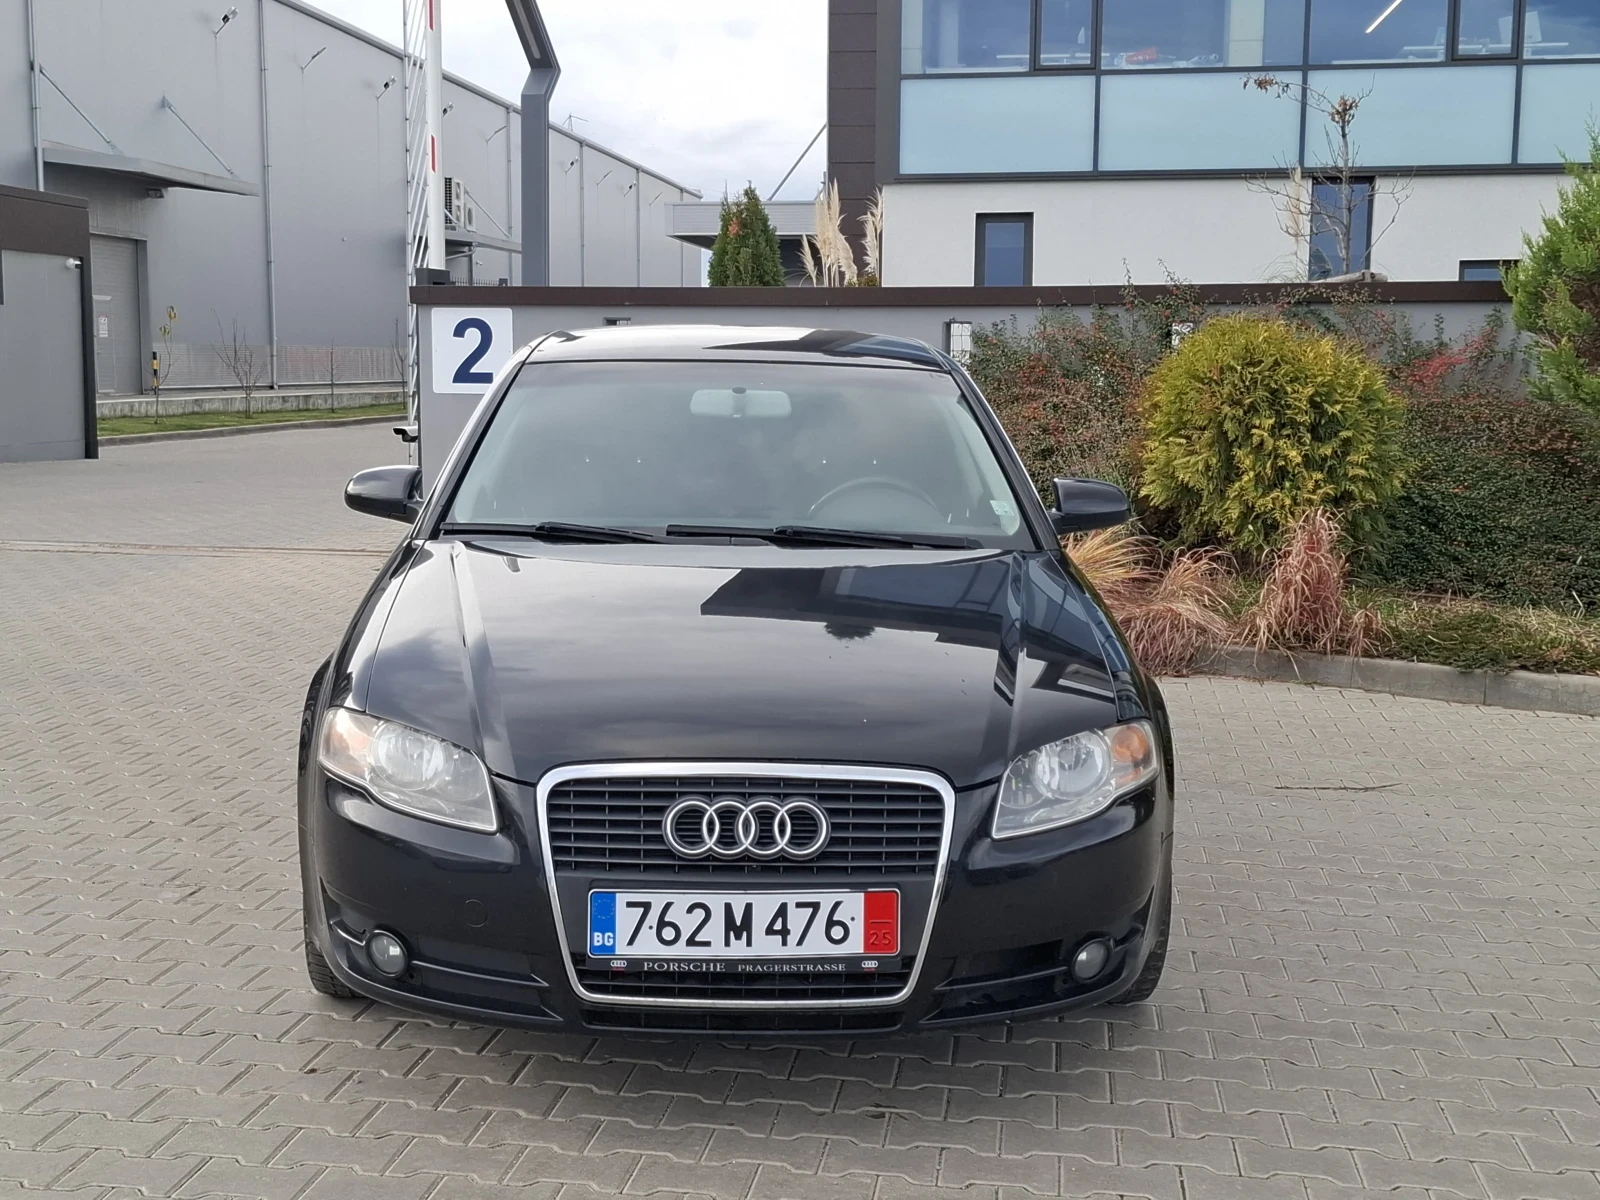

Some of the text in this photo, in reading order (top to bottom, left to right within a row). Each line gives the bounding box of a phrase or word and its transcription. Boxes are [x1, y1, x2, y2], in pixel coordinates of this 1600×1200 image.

[452, 317, 494, 384] 2
[593, 931, 614, 947] BG
[869, 930, 893, 946] 25
[643, 961, 846, 972] PORSCHE PRAGERSTRASSE
